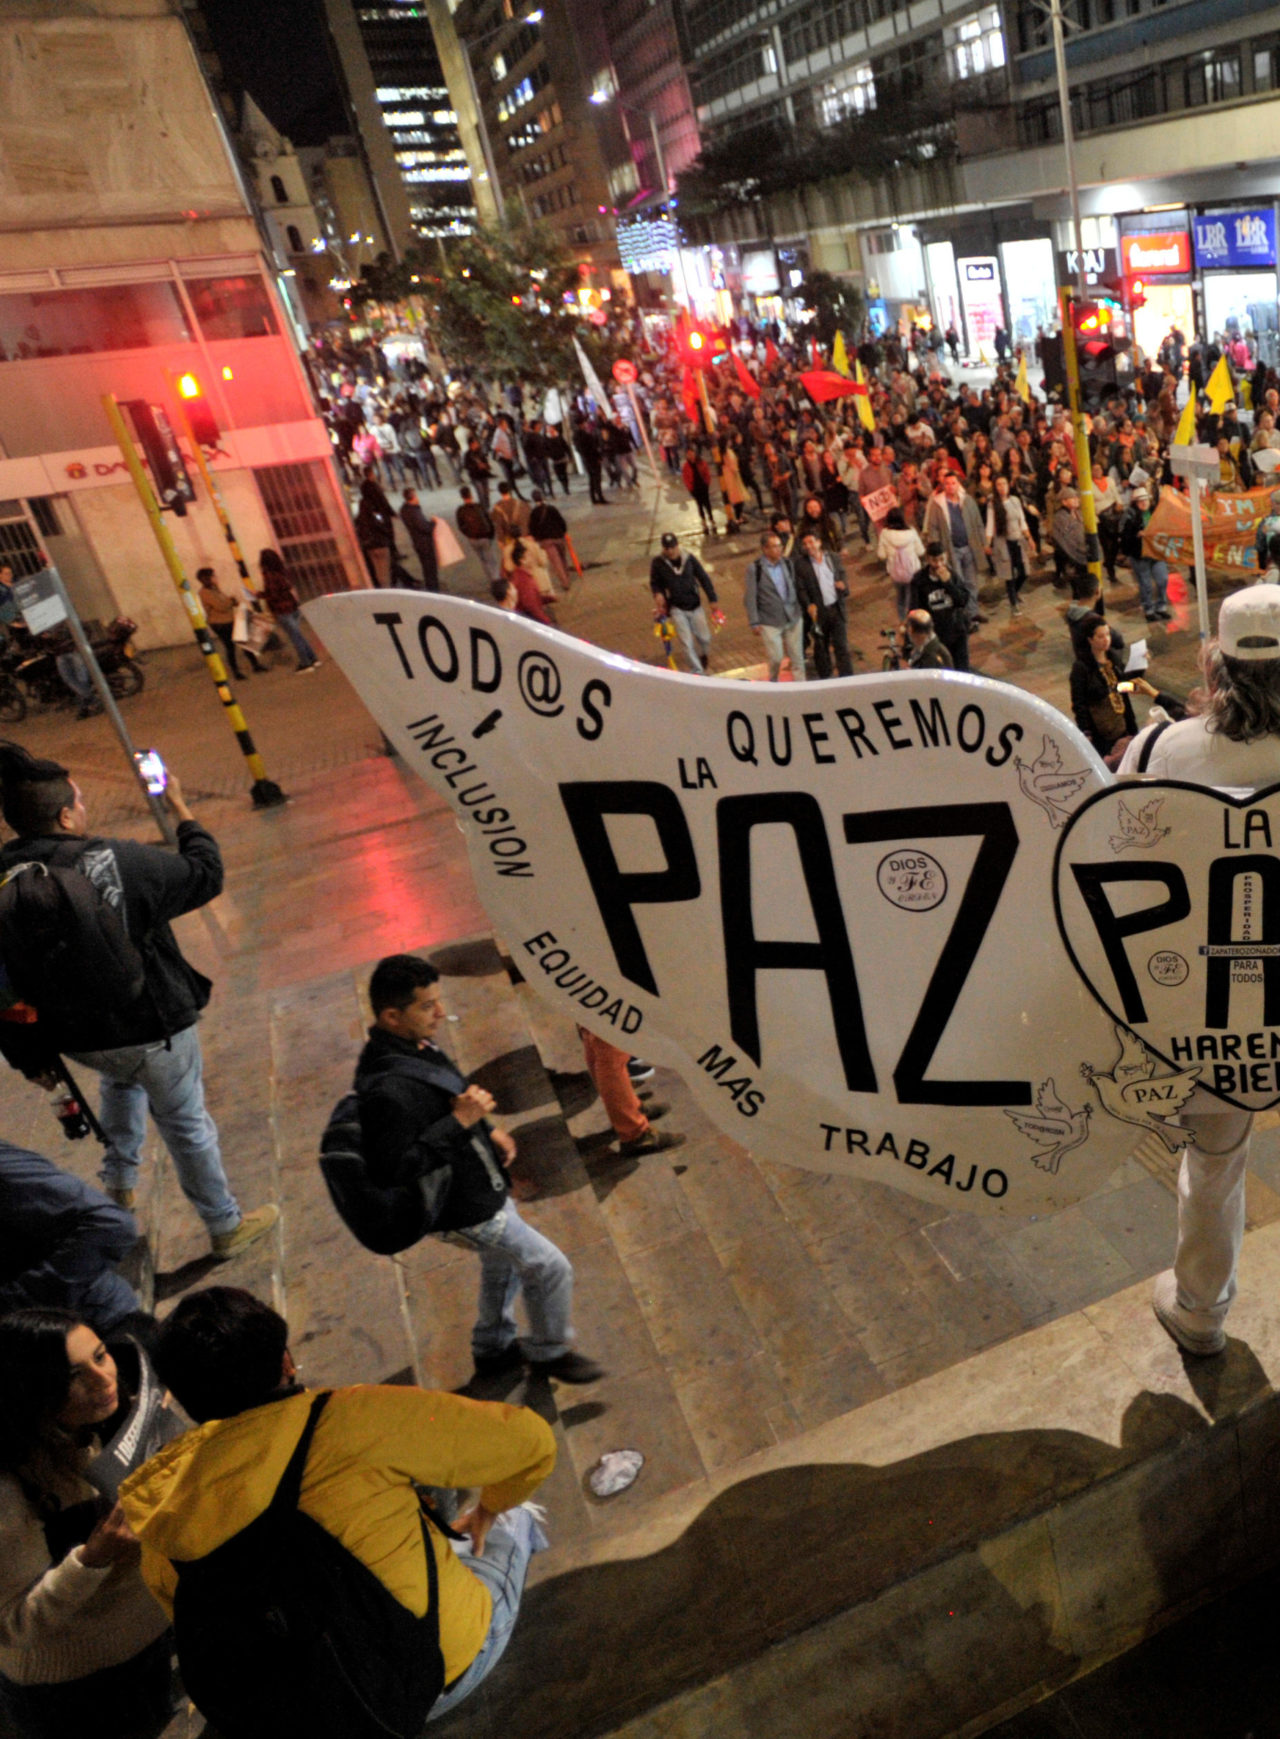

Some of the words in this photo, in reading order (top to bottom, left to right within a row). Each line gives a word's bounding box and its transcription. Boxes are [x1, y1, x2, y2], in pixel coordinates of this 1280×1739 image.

[373, 613, 611, 741] TOD@S
[727, 697, 1024, 768] QUEREMOS
[407, 714, 535, 878] INCLUSION
[678, 757, 718, 790] LA
[1223, 808, 1273, 850] LA
[889, 857, 928, 872] DIOS
[1242, 875, 1253, 941] PROSPERIDAD
[558, 779, 1033, 1107] PAZ
[1233, 961, 1259, 970] PARA
[523, 930, 644, 1035] EQUIDAD
[1231, 973, 1264, 983] TODOS
[696, 1044, 766, 1118] MAS
[820, 1122, 1009, 1199] TRABAJO
[1134, 1085, 1178, 1104] PAZ
